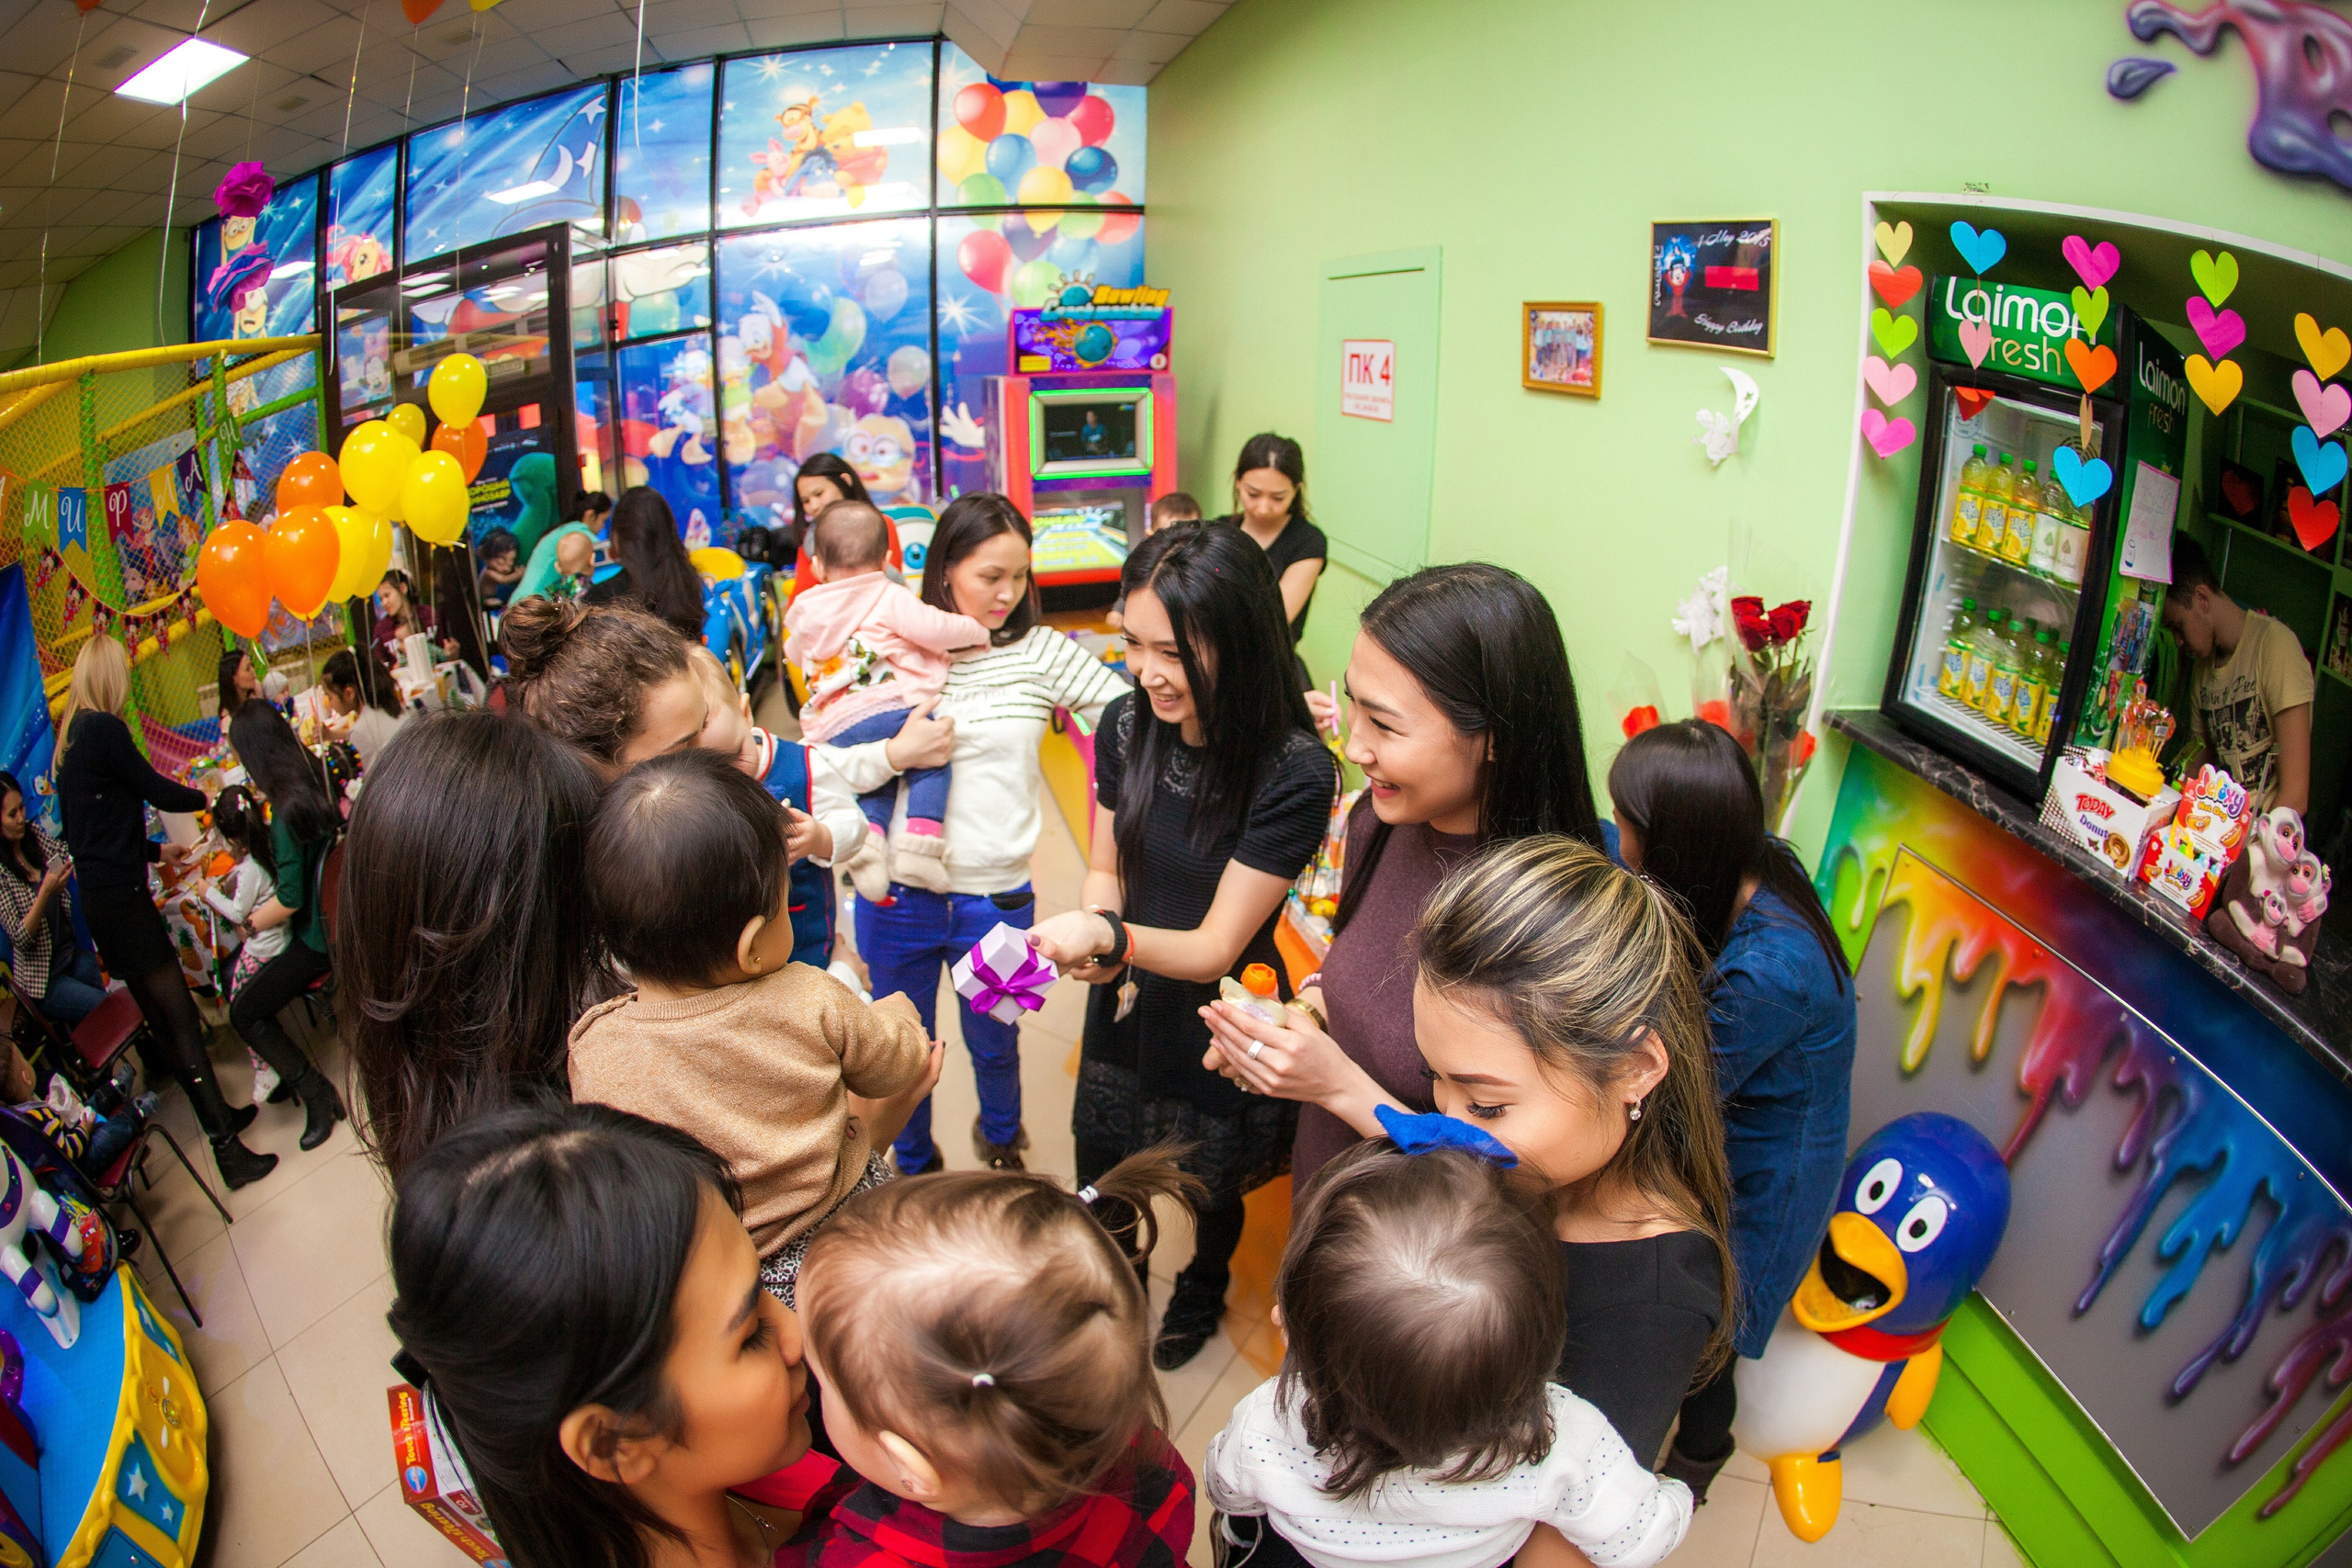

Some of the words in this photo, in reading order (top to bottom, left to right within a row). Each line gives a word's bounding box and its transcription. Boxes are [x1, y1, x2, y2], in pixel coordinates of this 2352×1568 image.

[1092, 285, 1171, 308] Bowling
[1693, 313, 1725, 335] Happy
[1984, 334, 2062, 377] resh
[1349, 353, 1374, 385] ПК
[1380, 354, 1391, 386] 4
[2139, 341, 2186, 416] Laimon
[2075, 794, 2116, 820] TODAY
[2198, 801, 2212, 813] Hot
[2212, 807, 2228, 823] Dog
[2079, 814, 2110, 839] Donut
